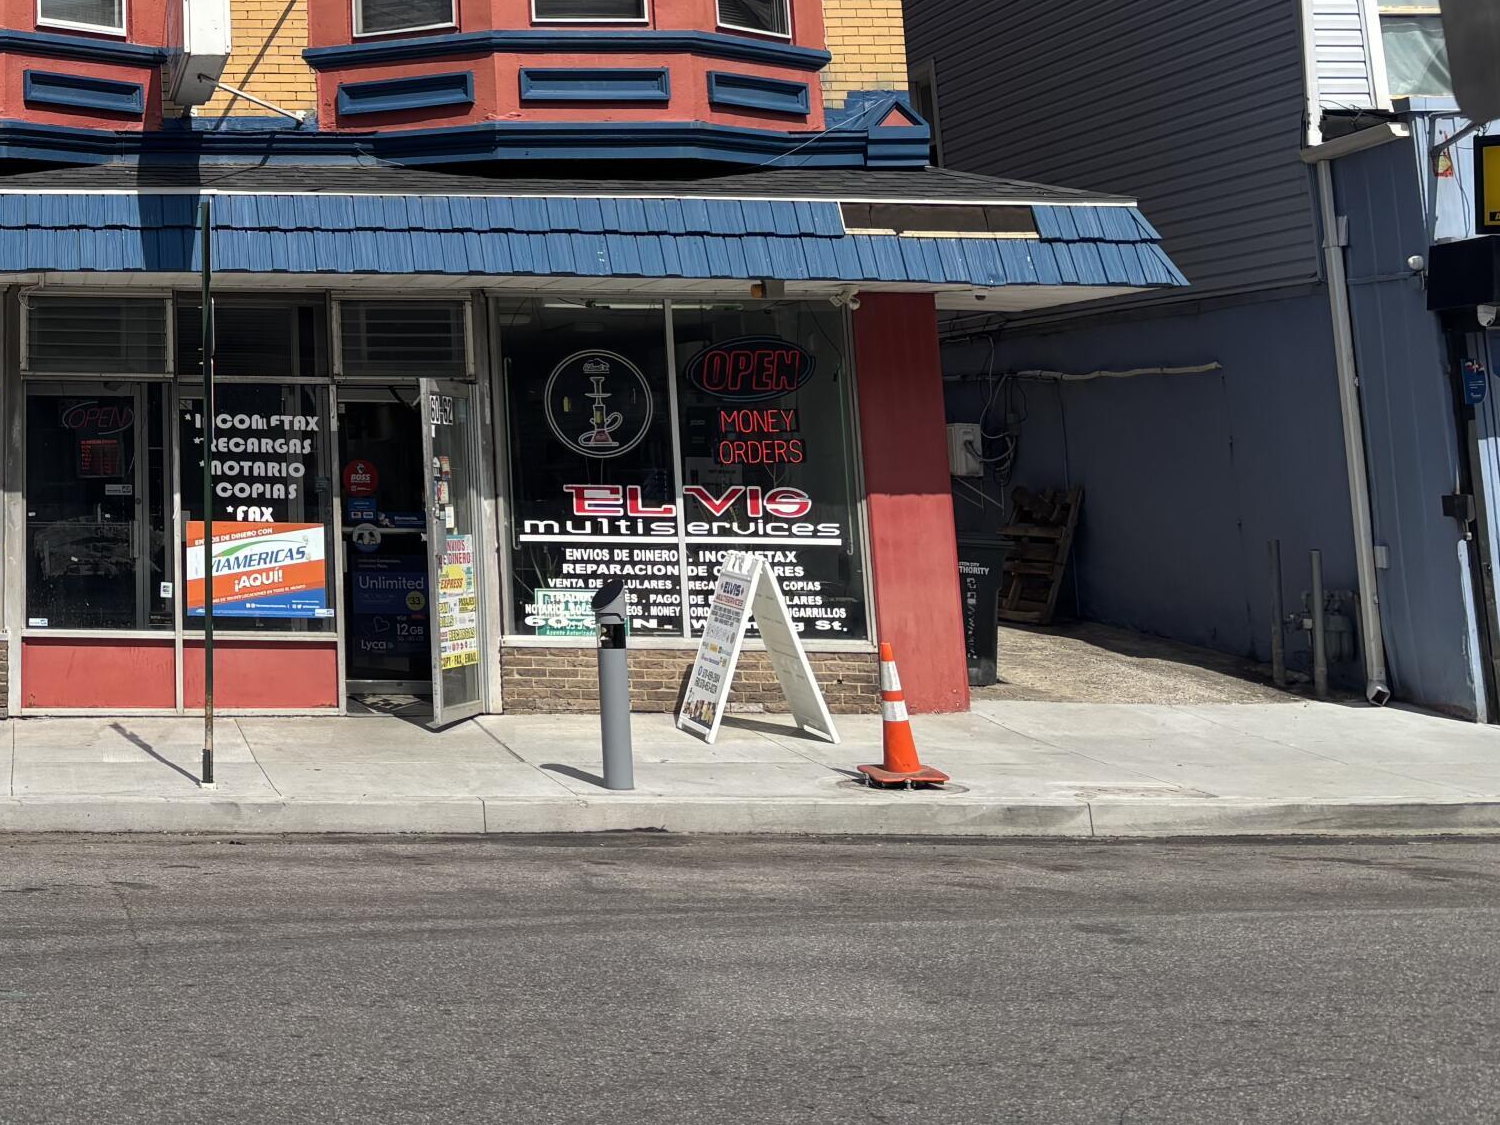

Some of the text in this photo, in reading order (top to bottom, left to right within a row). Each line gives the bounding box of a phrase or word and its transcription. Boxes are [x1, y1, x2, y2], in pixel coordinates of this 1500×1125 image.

[703, 350, 800, 390] OPEN
[68, 406, 127, 428] OPEN
[720, 409, 794, 433] MONEY
[719, 439, 803, 464] ORDERS
[211, 460, 306, 477] NOTARIO
[215, 482, 298, 499] COPIAS
[236, 506, 274, 522] FAX
[257, 527, 273, 536] CON
[565, 548, 610, 561] ENVIOS
[614, 549, 630, 561] DE
[633, 549, 679, 562] DINERO
[562, 563, 680, 575] REPARACION
[687, 565, 708, 576] DE
[959, 565, 990, 575] THORITY
[234, 566, 283, 592] ¡AQUÍ!
[358, 575, 425, 589] Unlimited
[548, 578, 585, 588] VENTA
[588, 579, 604, 588] DE
[783, 581, 821, 591] COPIAS
[723, 581, 741, 597] ELVIS
[649, 594, 681, 604] PAGO
[689, 595, 705, 604] DE
[650, 606, 681, 616] MONEY
[396, 623, 424, 635] 12 GB
[633, 618, 673, 628] N.
[814, 620, 848, 632] St.
[360, 639, 387, 651] Lyca
